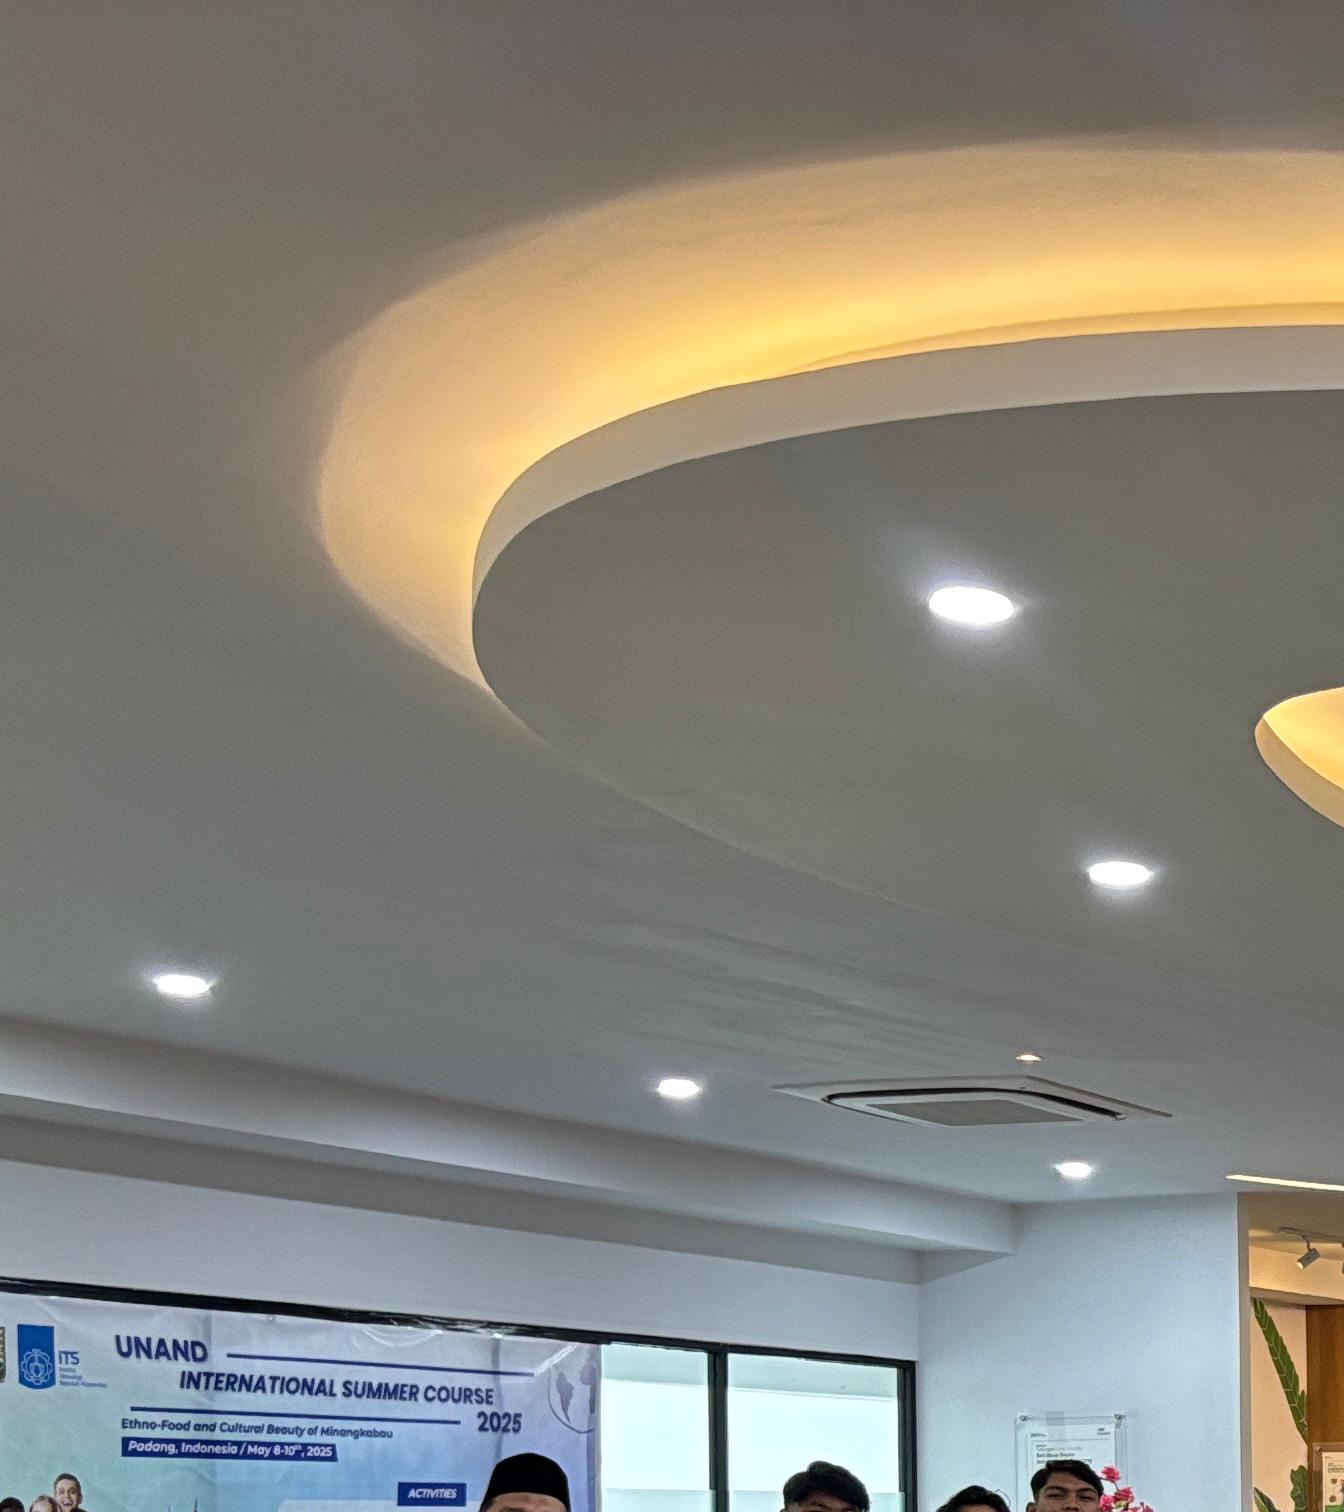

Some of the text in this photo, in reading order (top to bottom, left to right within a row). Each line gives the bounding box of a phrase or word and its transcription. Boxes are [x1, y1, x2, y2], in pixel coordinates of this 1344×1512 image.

[58, 1350, 79, 1365] ITS
[115, 1334, 208, 1363] UNAND
[179, 1371, 494, 1405] INTERNATIONAL SUMMER COURSE
[121, 1418, 393, 1440] Ethno-Food and Cultural Beauty of Minangkabau
[477, 1411, 522, 1433] 2025
[128, 1440, 179, 1455] Padang,
[181, 1442, 237, 1454] Indonesia
[247, 1445, 271, 1457] May
[306, 1446, 332, 1457] 2025
[408, 1488, 457, 1499] ACTIVITIES
